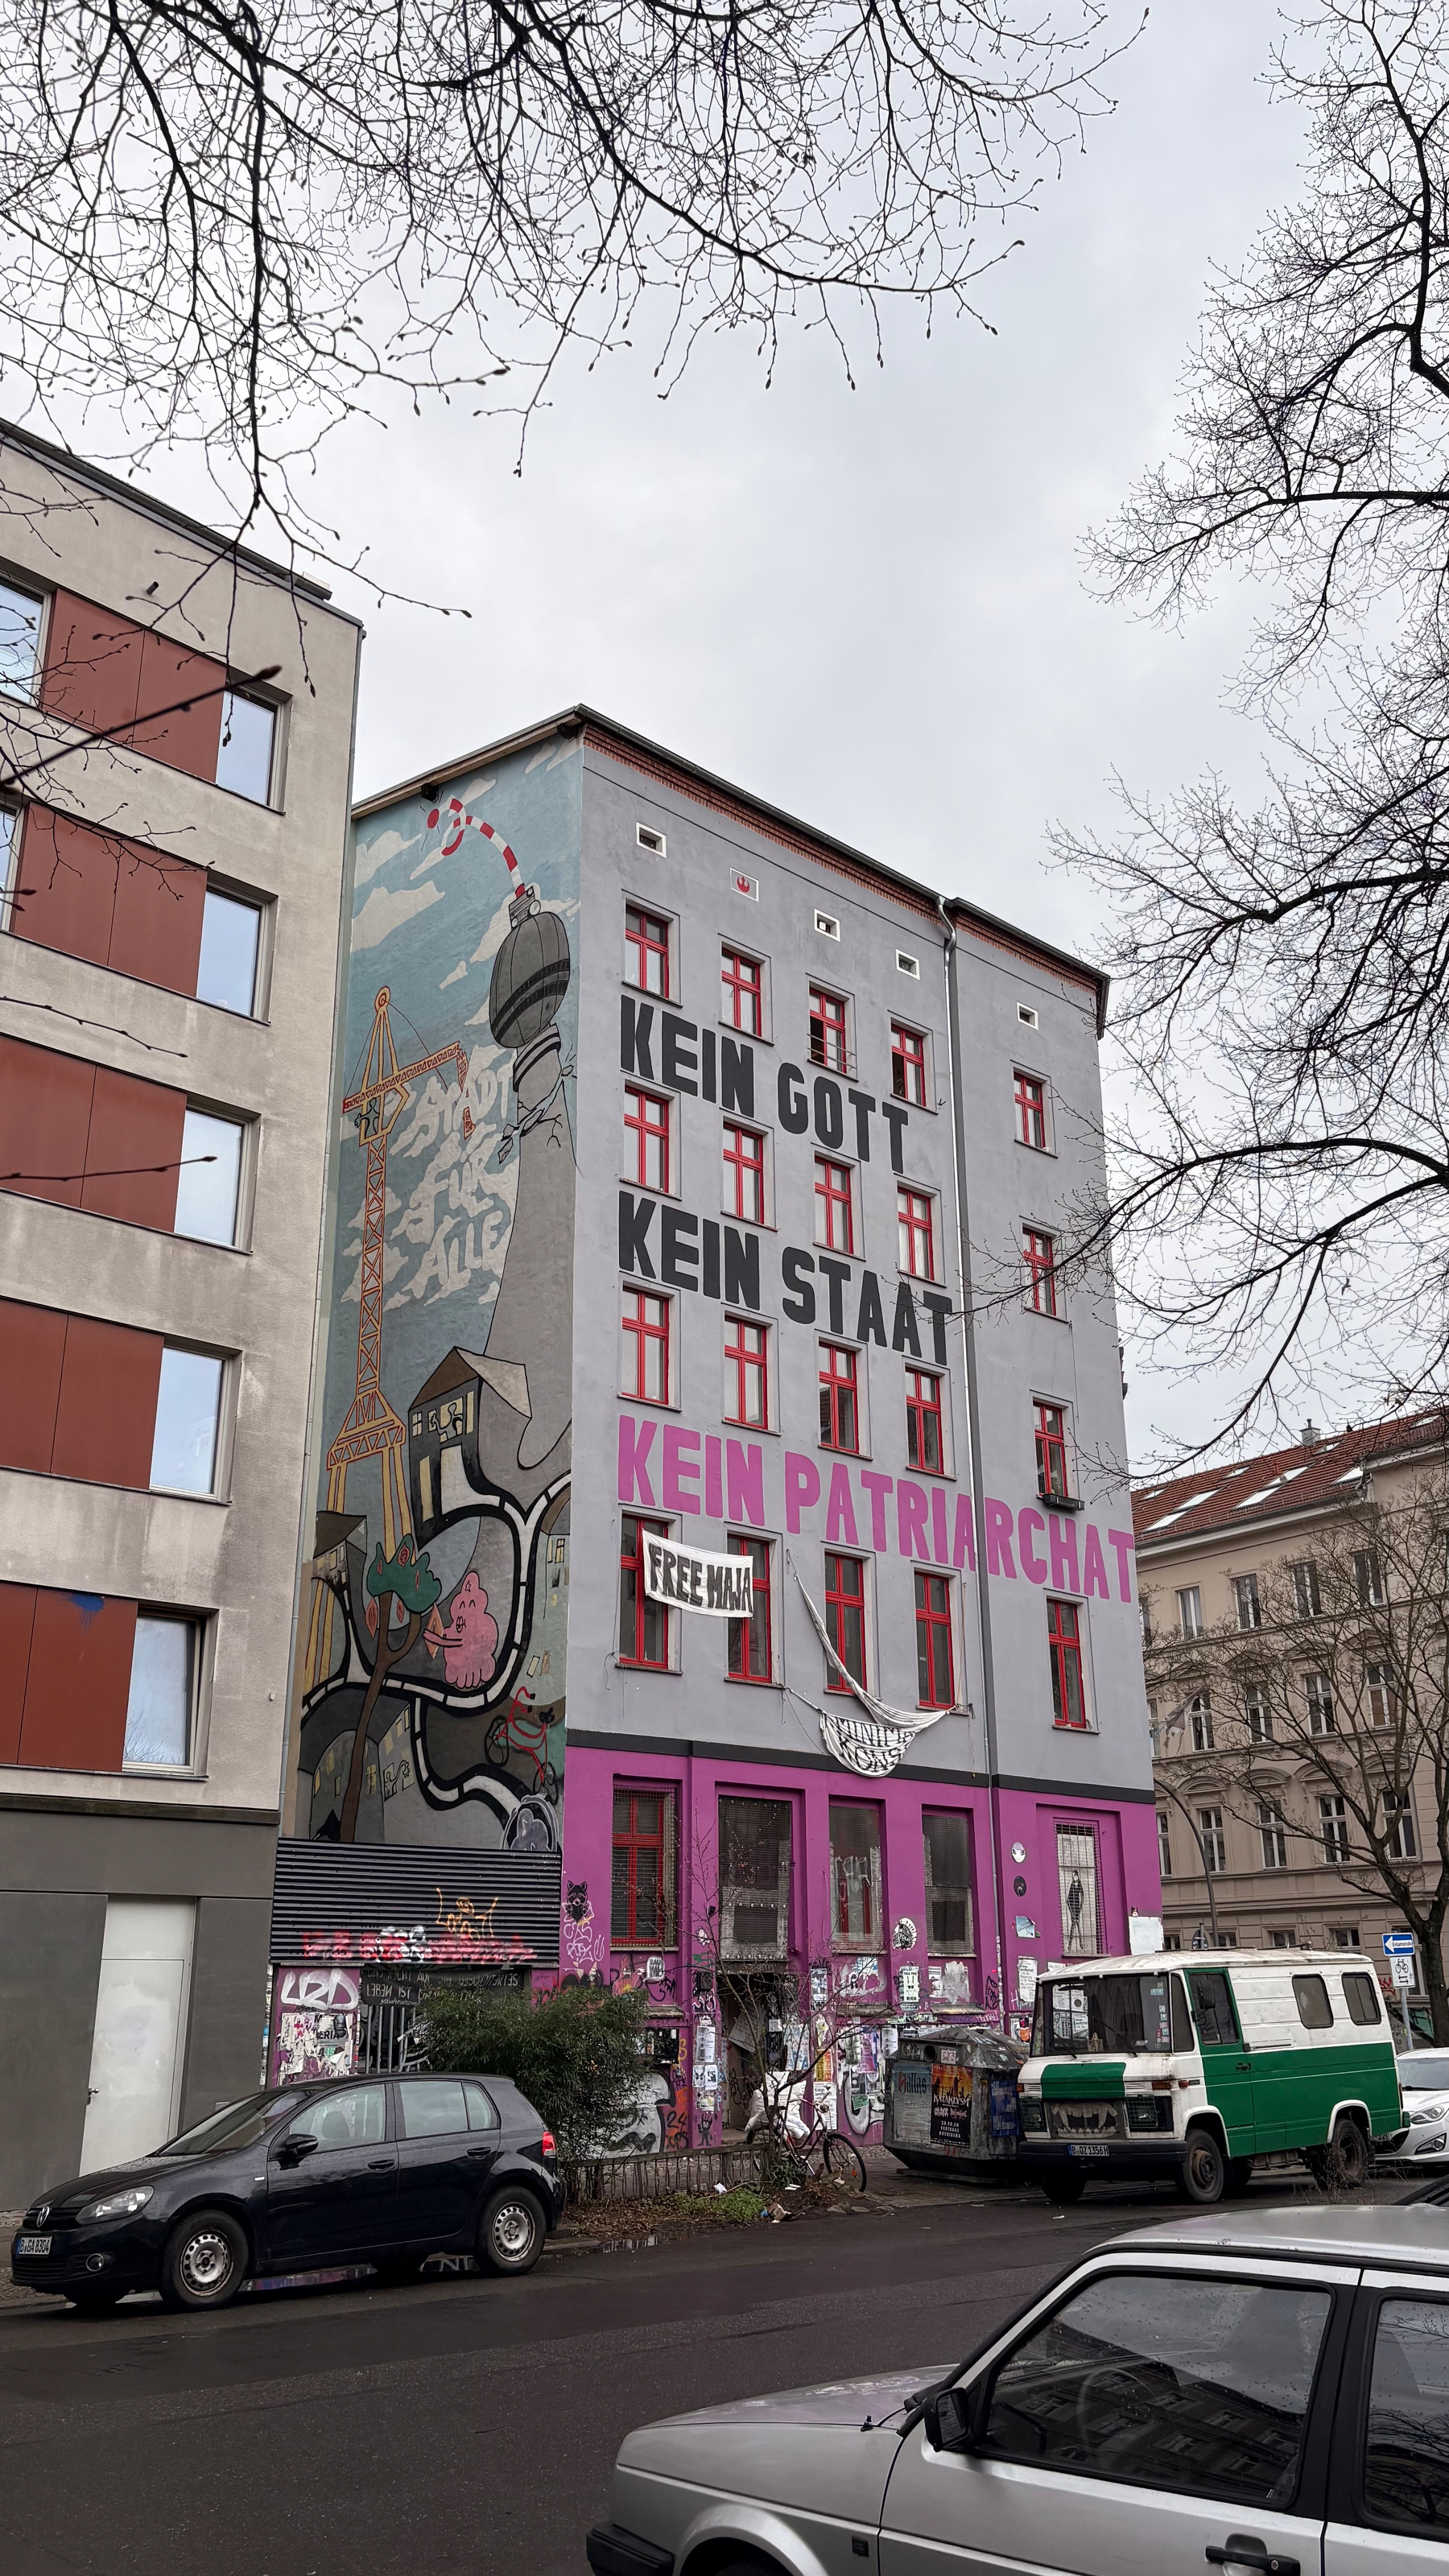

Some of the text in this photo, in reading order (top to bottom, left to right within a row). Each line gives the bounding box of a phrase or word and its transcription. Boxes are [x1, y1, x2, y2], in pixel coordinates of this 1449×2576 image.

[621, 994, 909, 1174] KEIN GOTT
[619, 1190, 952, 1366] KEIN STAAT
[618, 1415, 1134, 1603] KEIN PATRIARCHAT
[649, 1542, 753, 1613] FREE MAJA
[366, 1983, 393, 1998] LEBEN
[398, 1986, 415, 2000] IST
